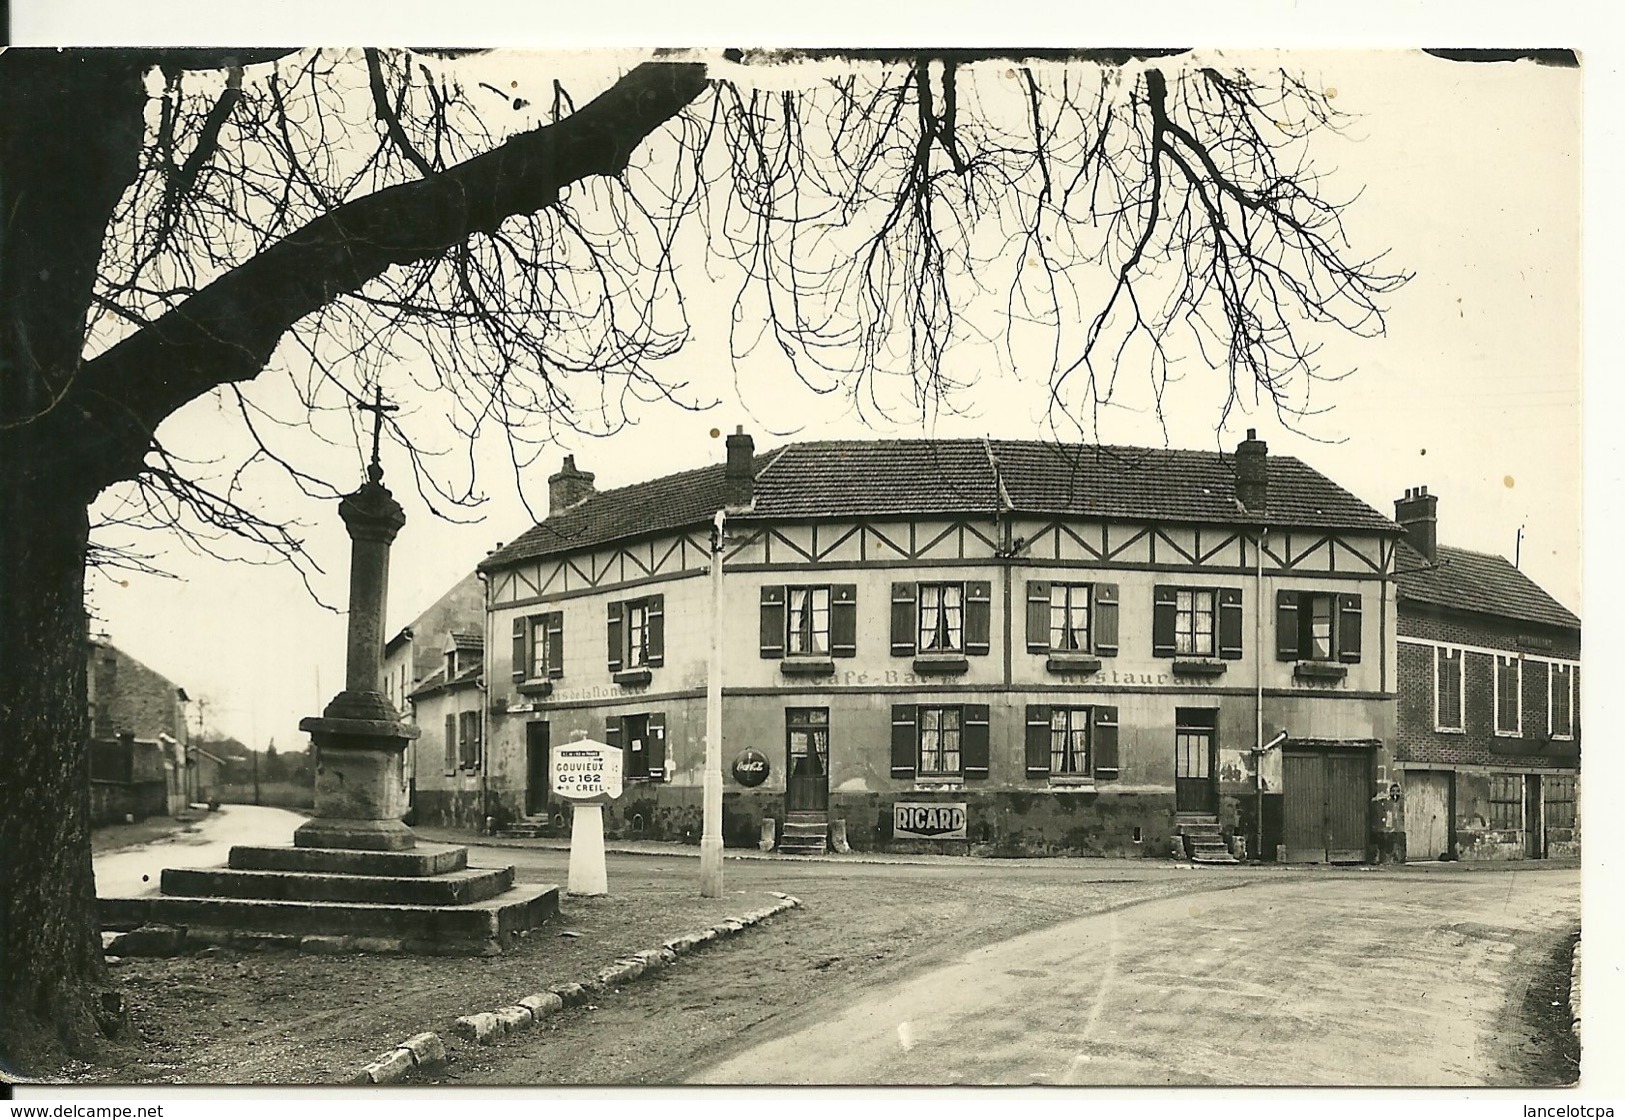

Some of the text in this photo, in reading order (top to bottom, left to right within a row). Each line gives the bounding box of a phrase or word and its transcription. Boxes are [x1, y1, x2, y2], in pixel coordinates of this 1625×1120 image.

[556, 763, 604, 772] GOUVIEUX
[578, 774, 601, 783] 162
[576, 784, 604, 792] CREIL
[896, 807, 964, 830] RICARD
